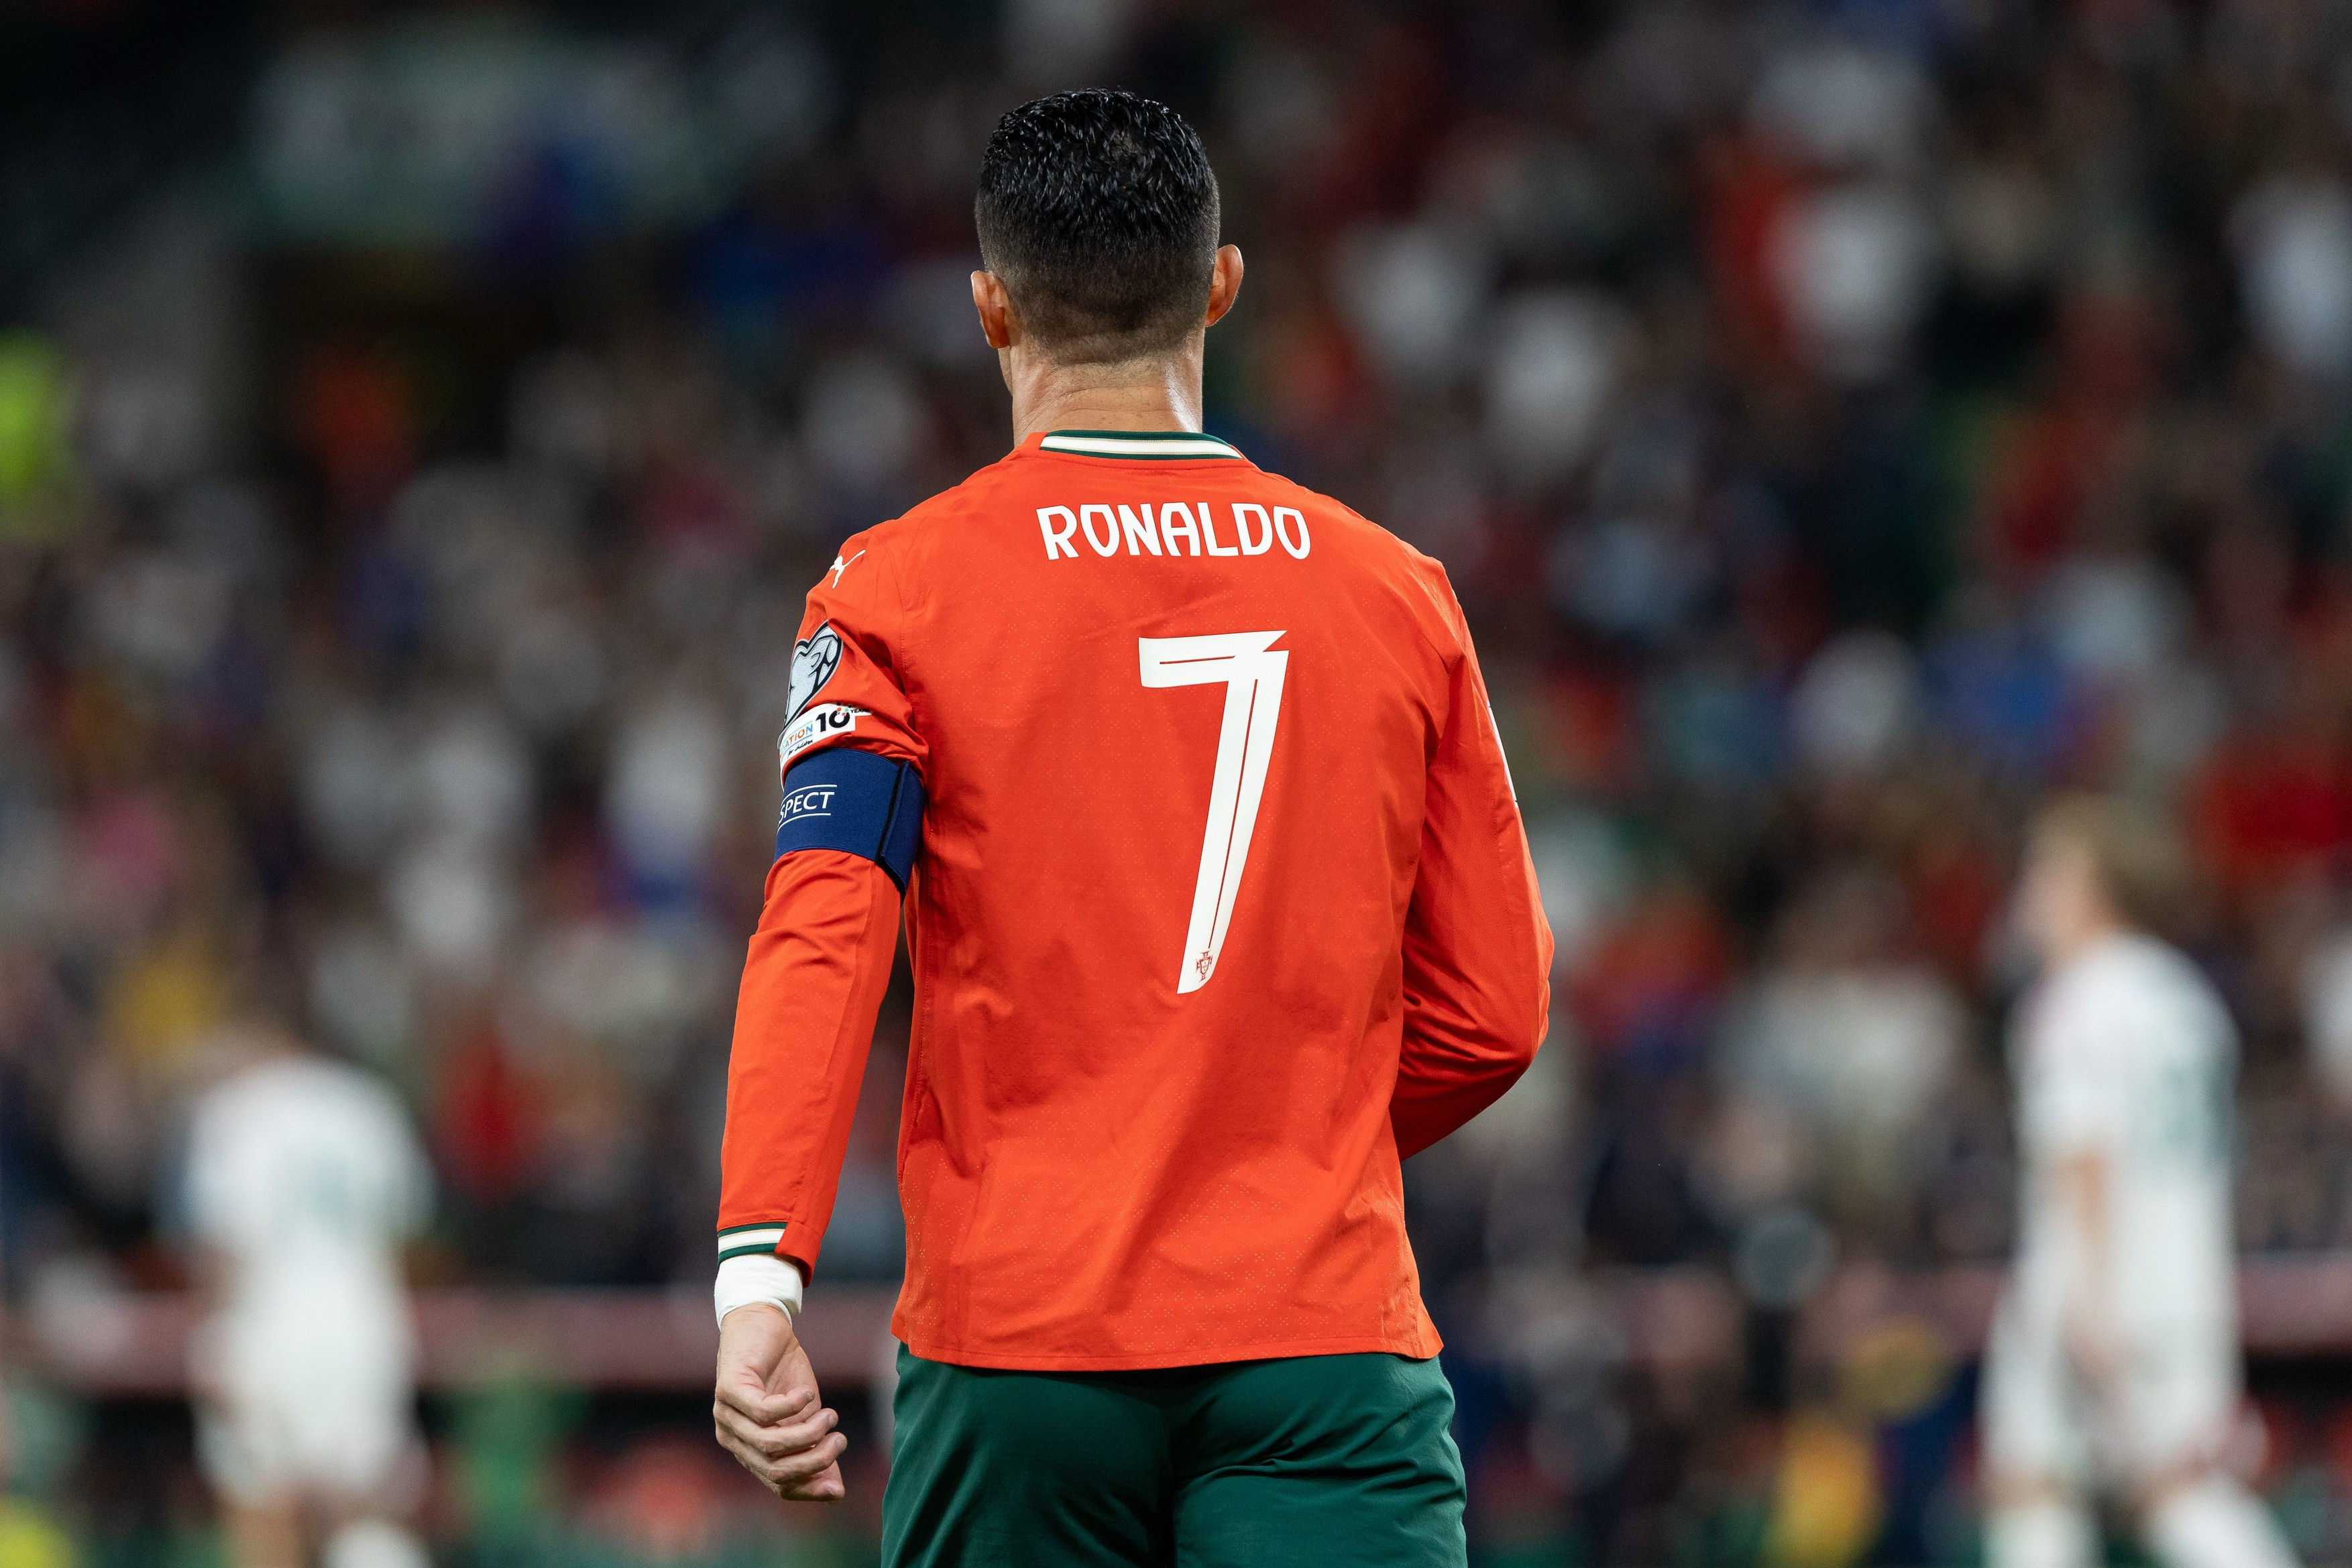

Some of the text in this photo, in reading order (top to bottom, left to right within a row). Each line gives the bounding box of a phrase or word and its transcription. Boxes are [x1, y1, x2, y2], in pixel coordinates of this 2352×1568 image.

[1036, 502, 1311, 560] RONALDO
[783, 724, 813, 748] ATION
[816, 709, 850, 732] 10
[1138, 630, 1290, 994] 7
